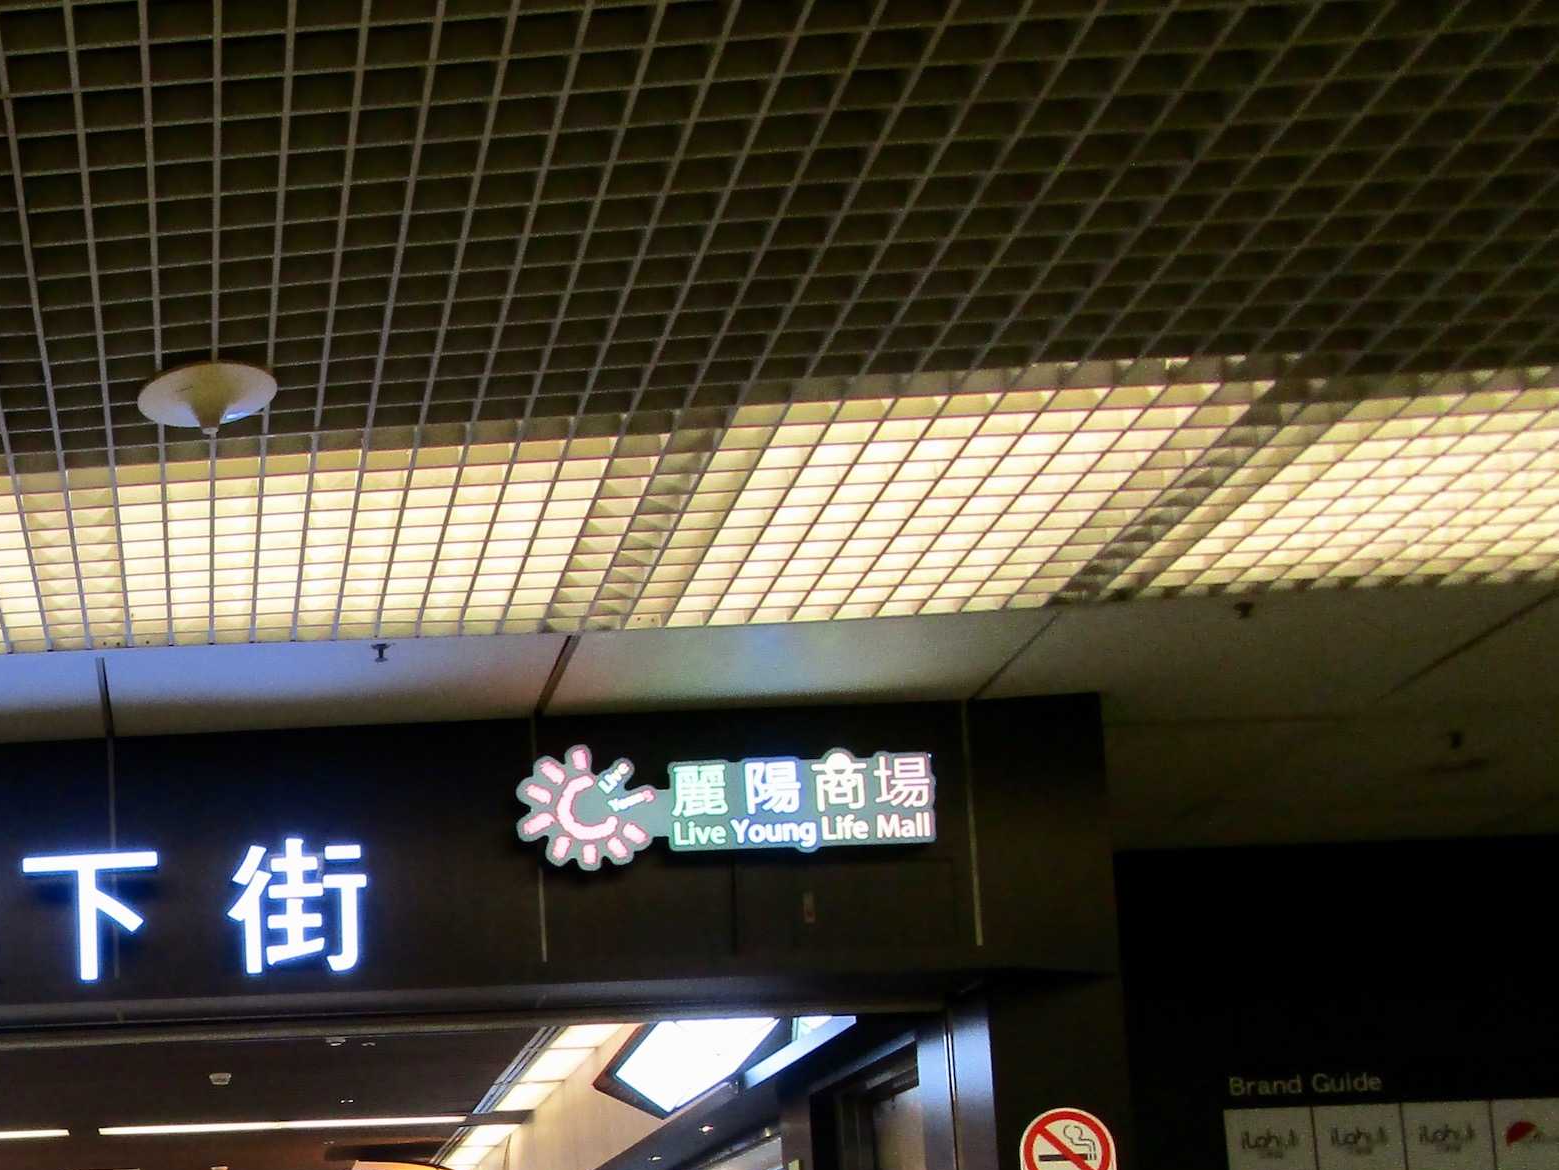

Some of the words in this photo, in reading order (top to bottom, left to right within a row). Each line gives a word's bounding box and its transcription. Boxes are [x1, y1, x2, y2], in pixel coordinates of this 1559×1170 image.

[598, 762, 629, 794] Live
[672, 753, 930, 817] 麗陽商場
[674, 821, 726, 847] Live
[730, 819, 816, 849] Young
[822, 814, 869, 841] Life
[875, 812, 930, 838] Mall
[1228, 1074, 1303, 1097] Brand
[1312, 1072, 1384, 1093] Guide
